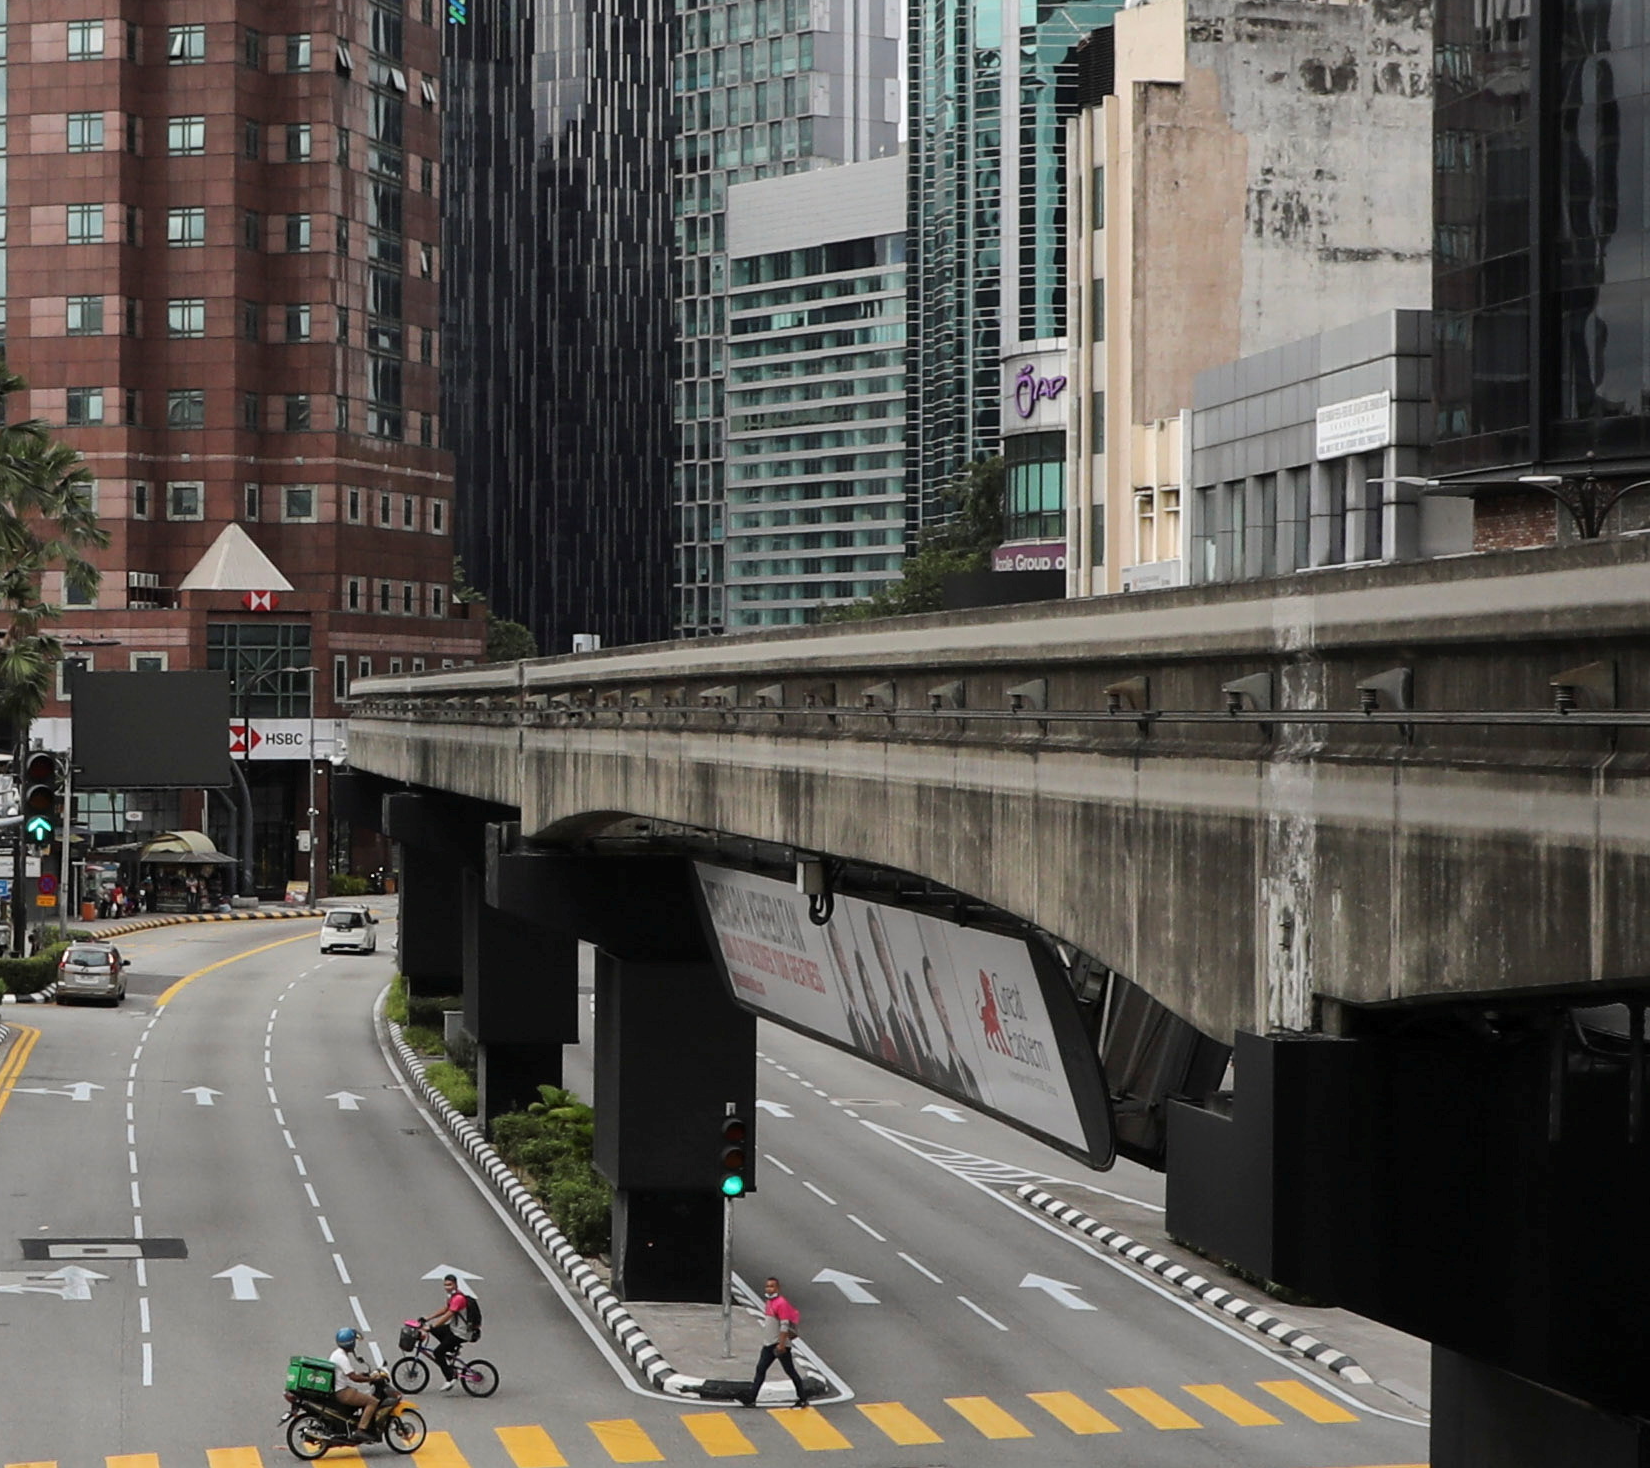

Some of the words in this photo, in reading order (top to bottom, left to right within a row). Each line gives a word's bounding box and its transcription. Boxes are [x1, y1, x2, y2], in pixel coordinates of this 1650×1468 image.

[265, 732, 303, 745] HSBC
[991, 973, 1028, 1022] Great
[1001, 1017, 1052, 1072] Eastern
